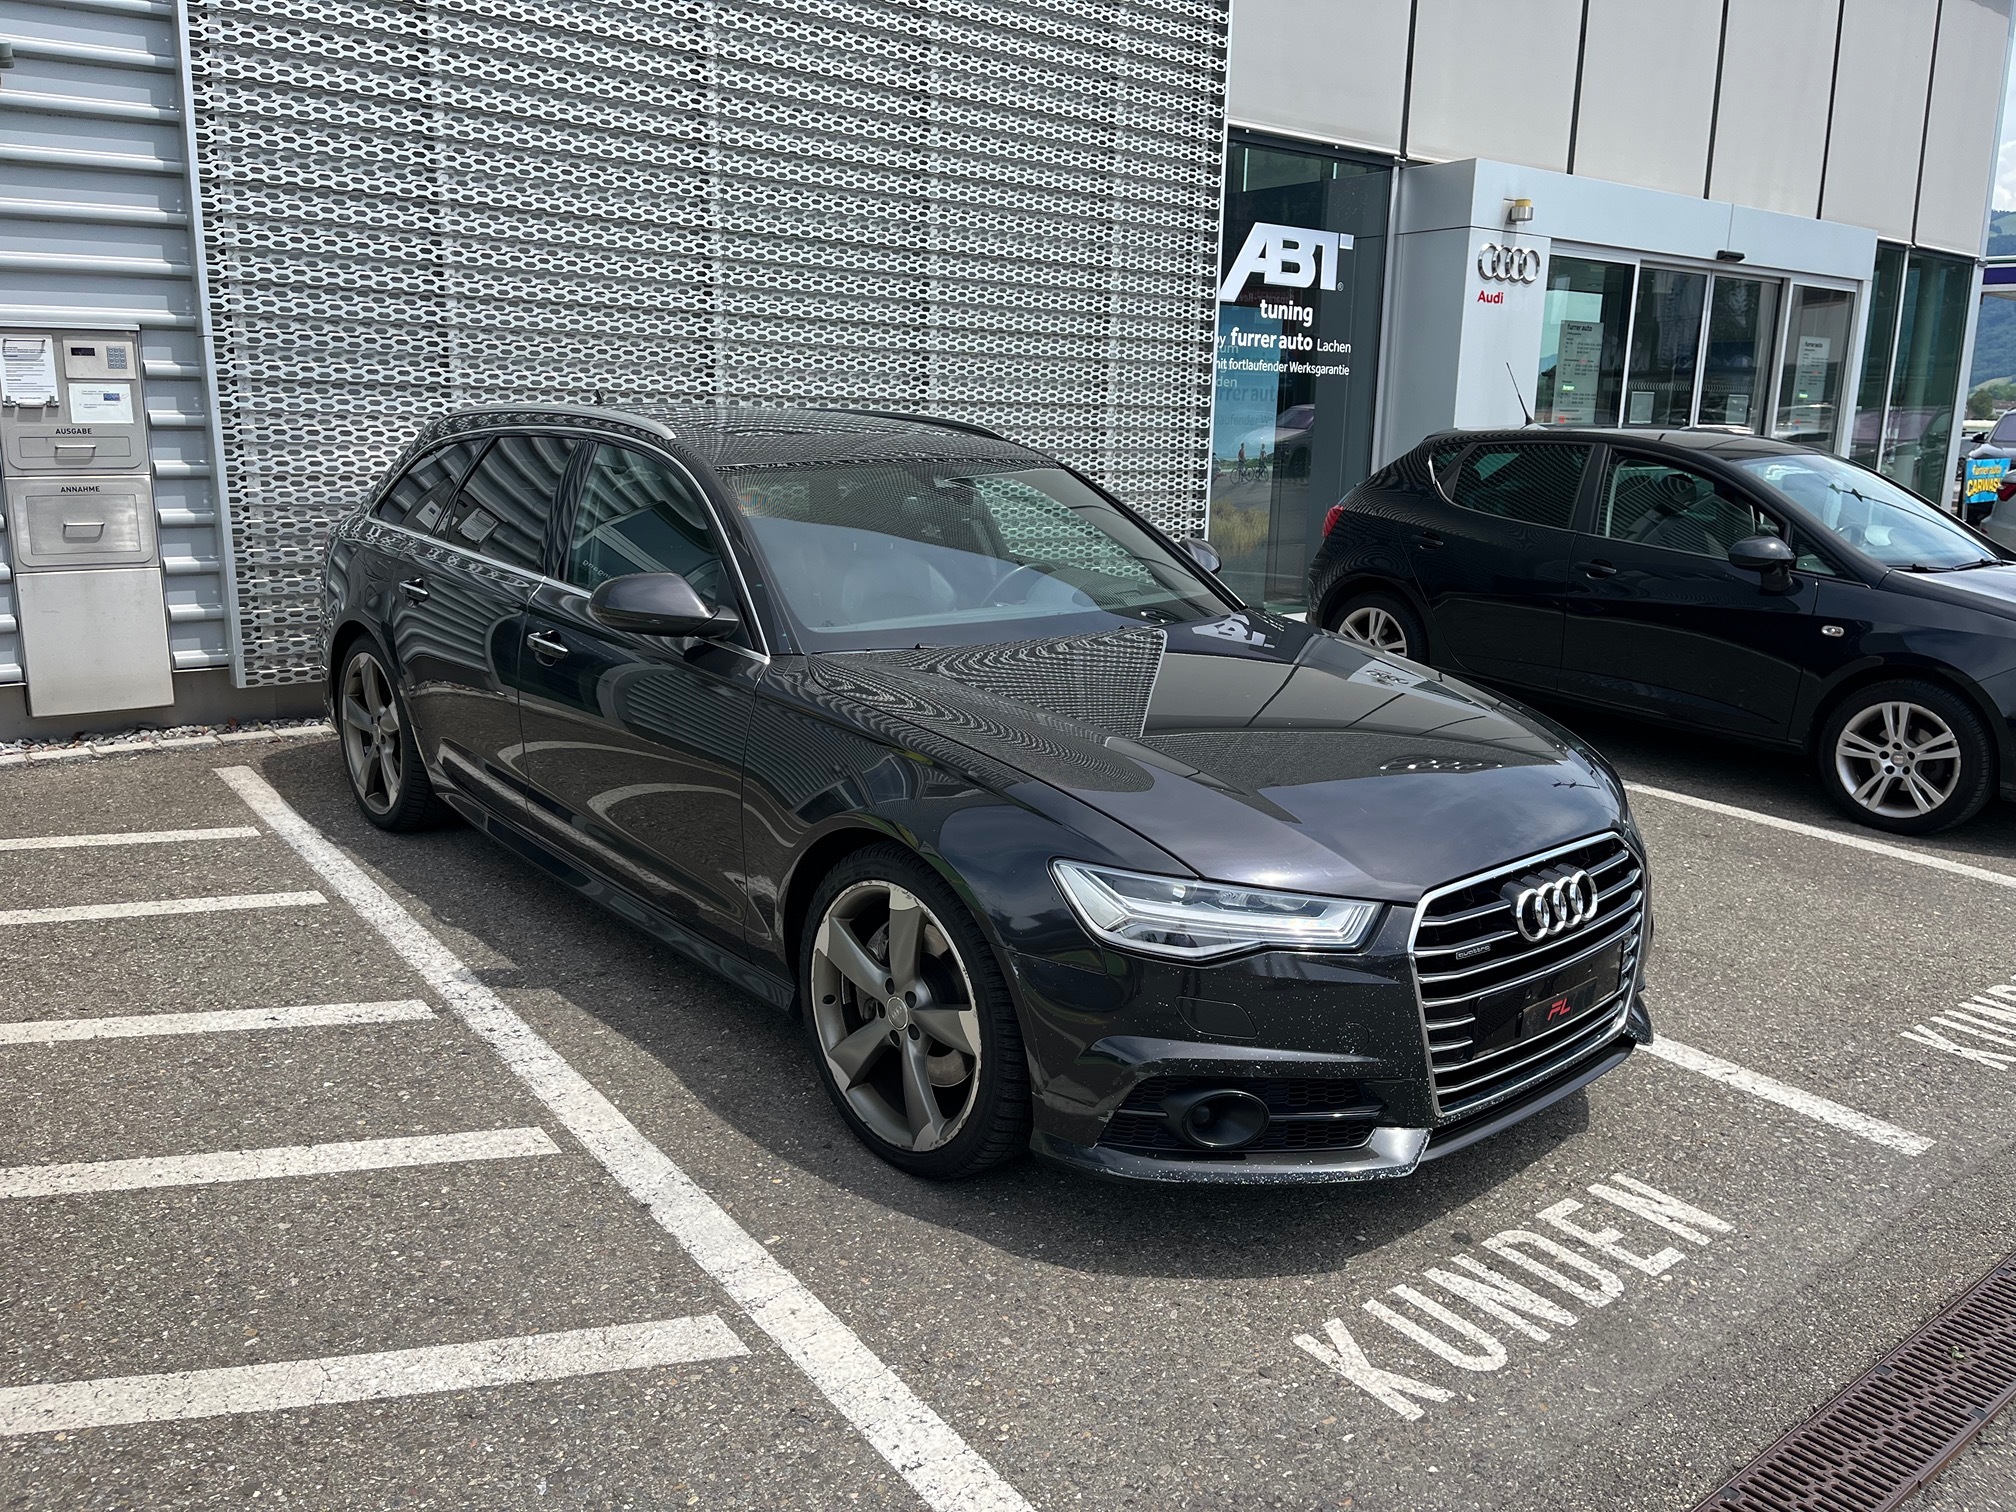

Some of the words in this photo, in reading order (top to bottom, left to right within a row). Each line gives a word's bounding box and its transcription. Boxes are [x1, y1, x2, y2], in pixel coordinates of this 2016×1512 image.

[1219, 222, 1355, 302] ABT
[1477, 290, 1504, 304] Audi
[1260, 299, 1313, 327] tuning
[1231, 327, 1277, 348] furrer
[1279, 333, 1313, 352] auto
[1316, 338, 1351, 354] Lachen
[1229, 358, 1288, 373] fortlaufender
[1289, 361, 1350, 377] Werksgarantie
[55, 427, 93, 435] AUSGABE
[60, 485, 101, 493] ANNAHME
[1457, 944, 1491, 960] quattro
[1547, 998, 1571, 1021] FL
[1292, 1171, 1737, 1423] KUNDEN
